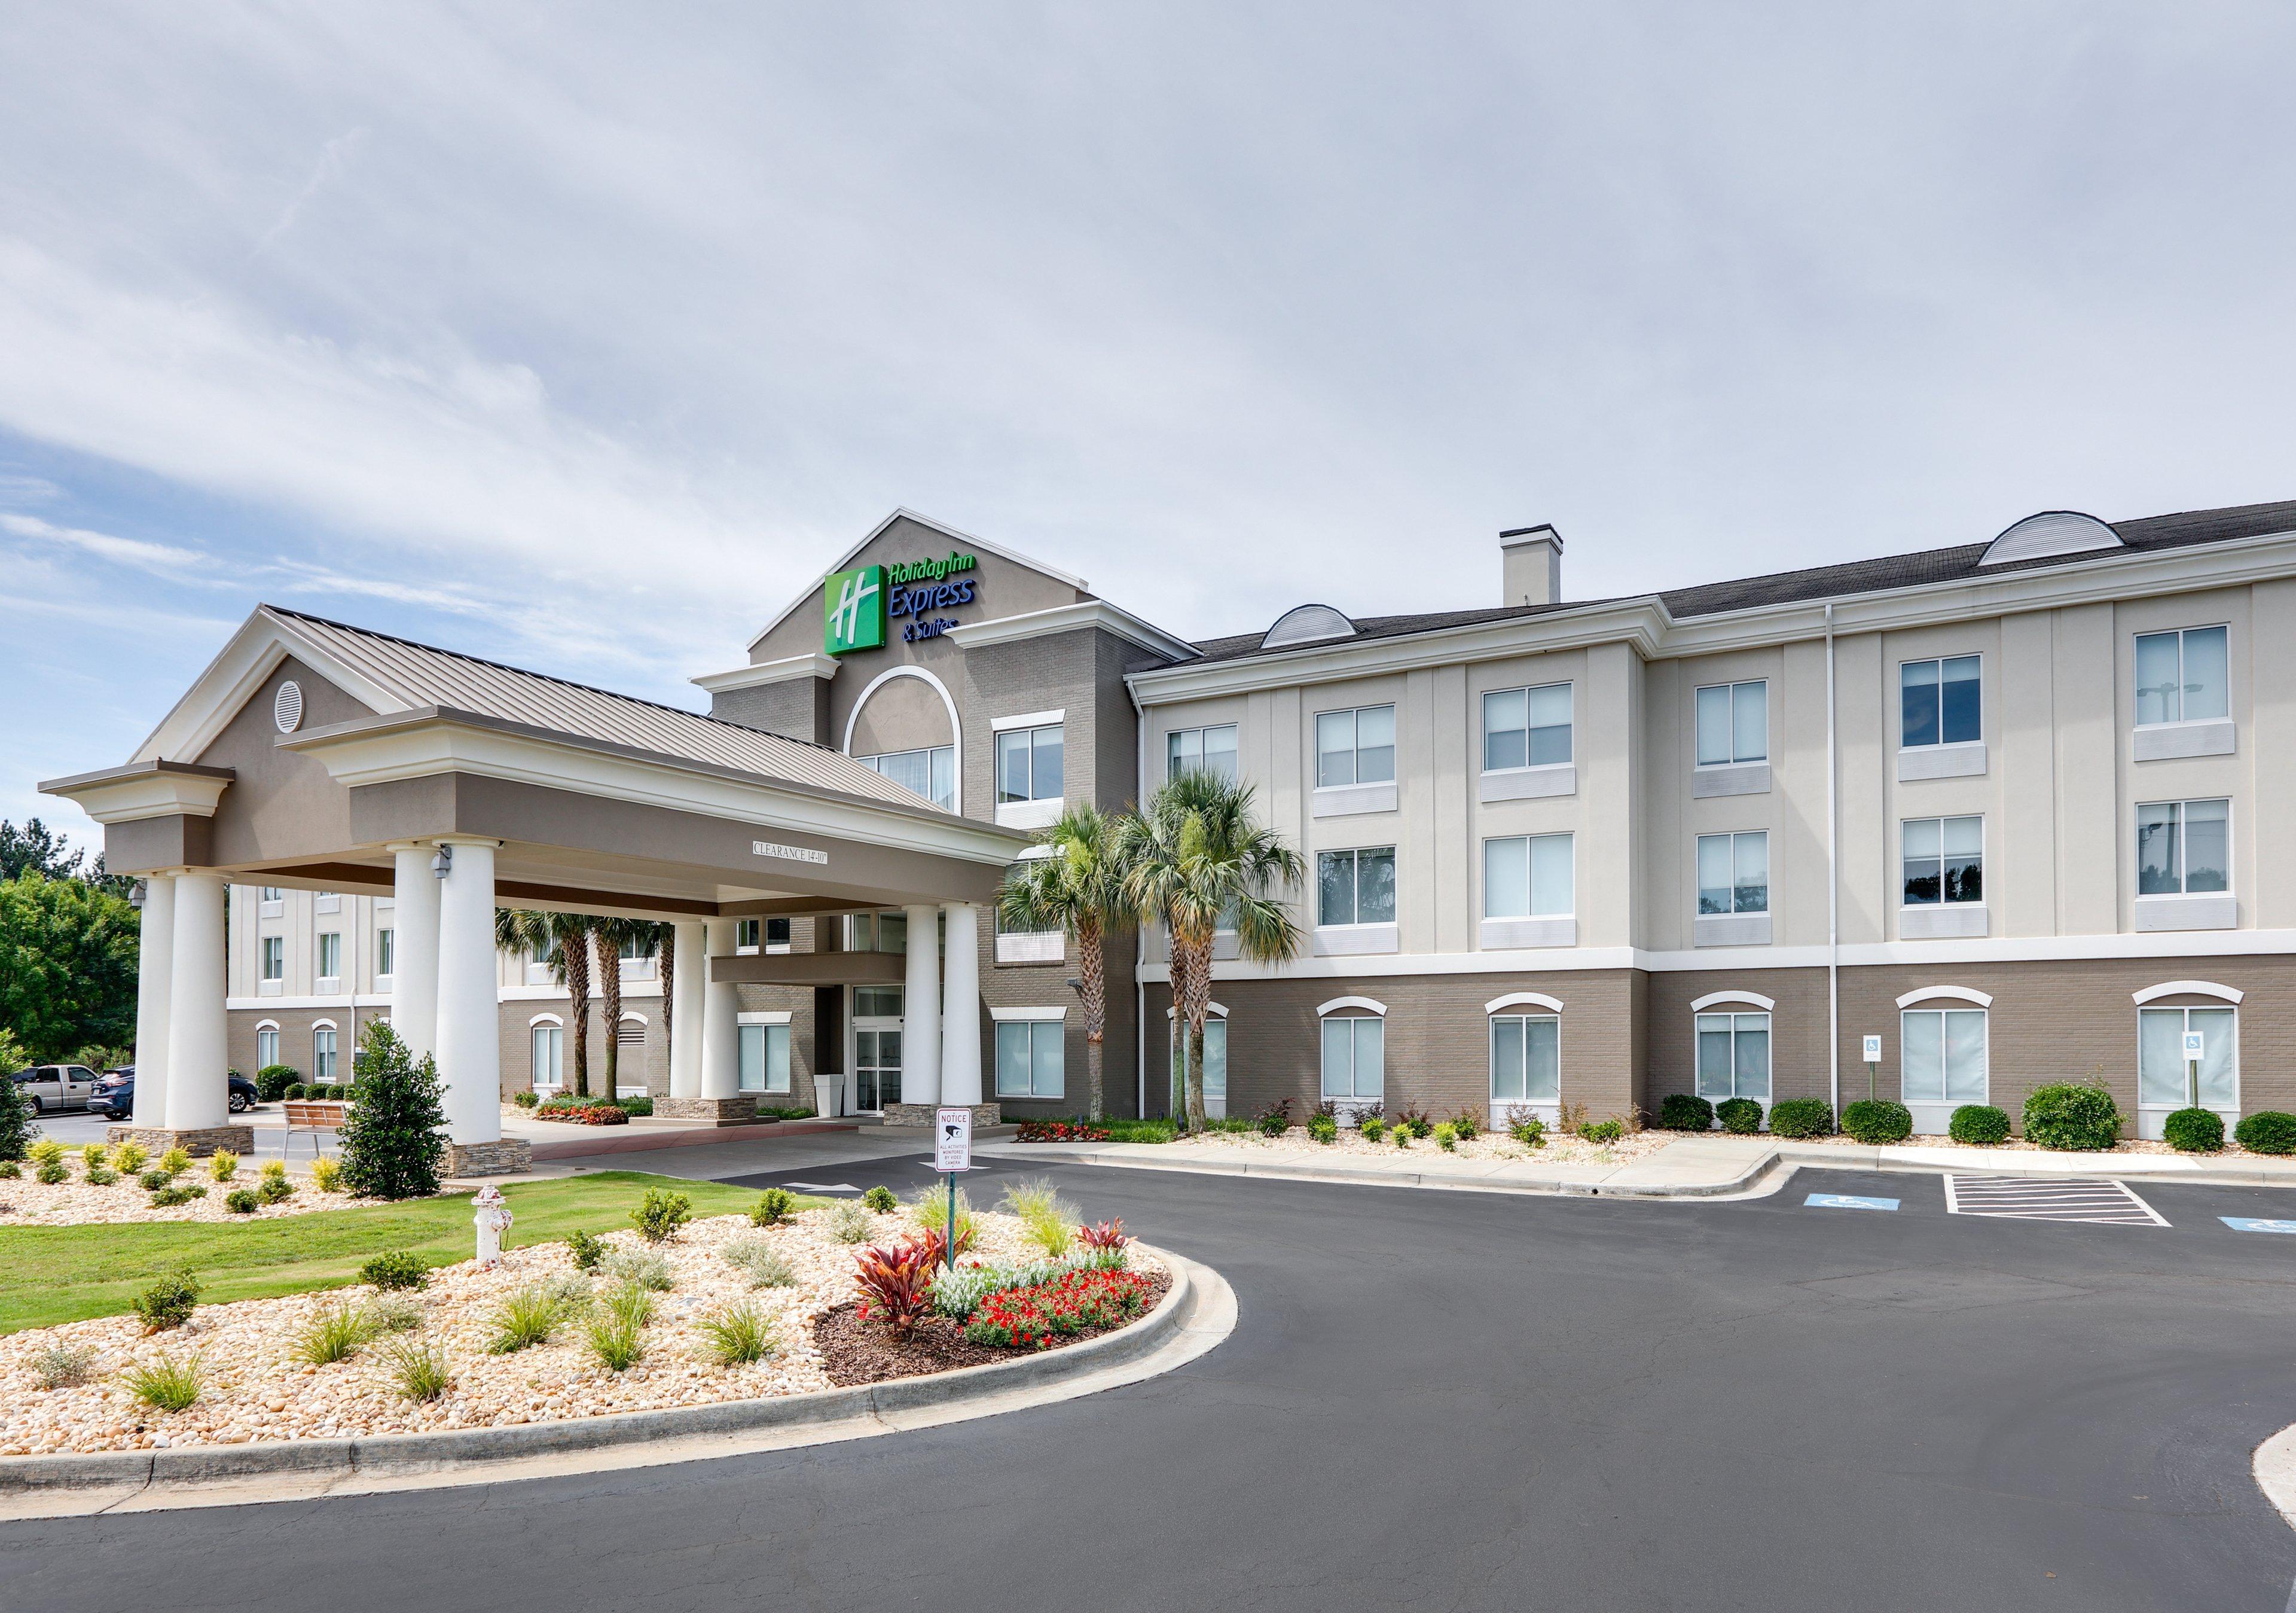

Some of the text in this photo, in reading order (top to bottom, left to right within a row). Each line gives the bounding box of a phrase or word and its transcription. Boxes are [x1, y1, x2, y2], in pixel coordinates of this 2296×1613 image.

[888, 550, 976, 585] Holiday Inn
[889, 579, 976, 620] Express
[902, 623, 915, 642] &
[754, 842, 805, 861] CLEARANCE
